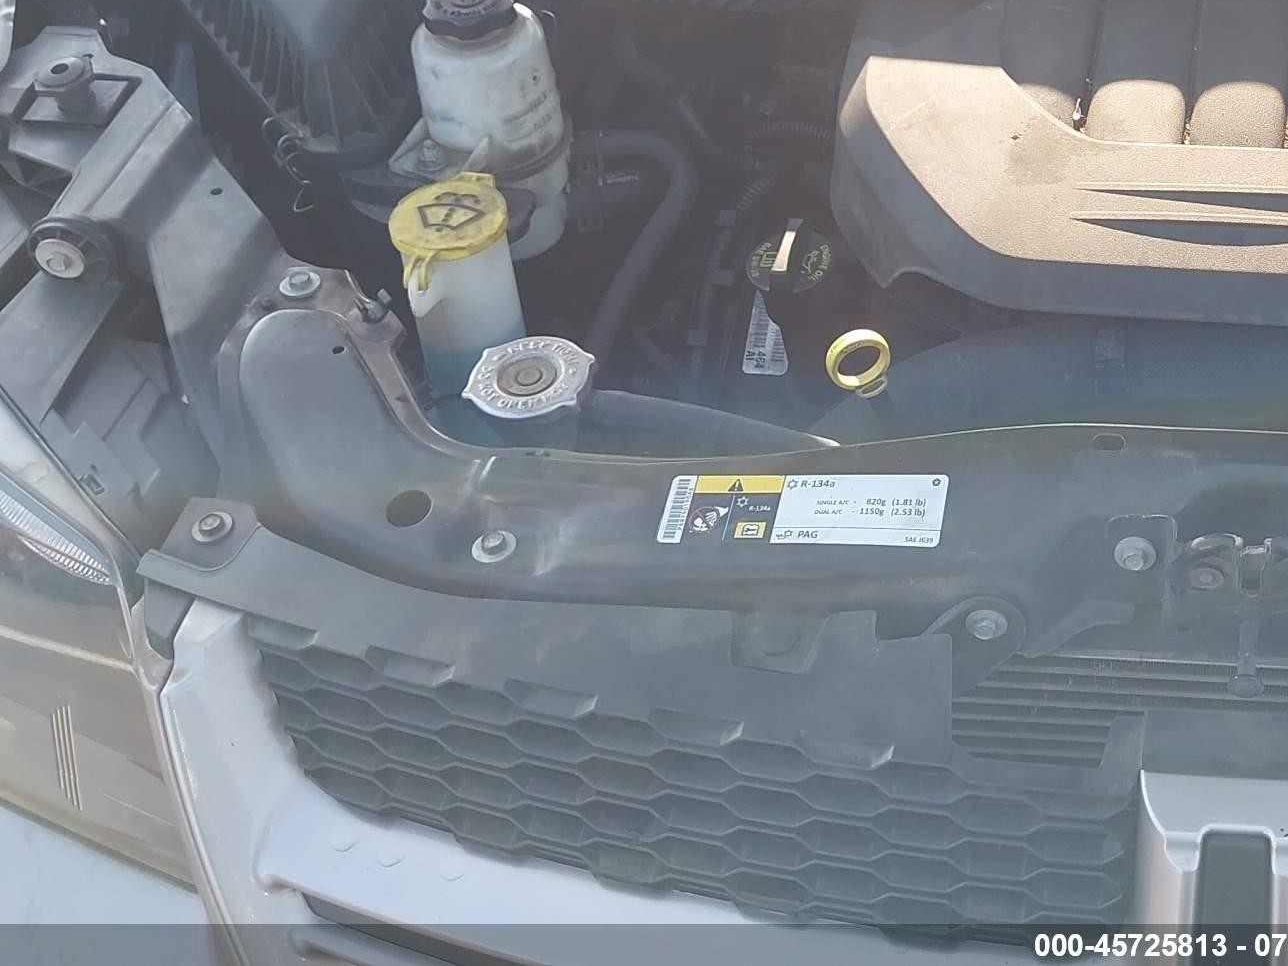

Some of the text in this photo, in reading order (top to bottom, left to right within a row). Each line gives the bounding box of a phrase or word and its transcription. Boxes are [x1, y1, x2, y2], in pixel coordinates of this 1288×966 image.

[800, 479, 836, 489] R-134a
[866, 498, 886, 507] 820g
[891, 497, 913, 507] (1.81
[914, 497, 927, 507] lb)
[859, 507, 885, 516] 1150g
[890, 507, 912, 517] (2.53
[914, 507, 926, 518] lb)
[797, 529, 819, 539] PAG
